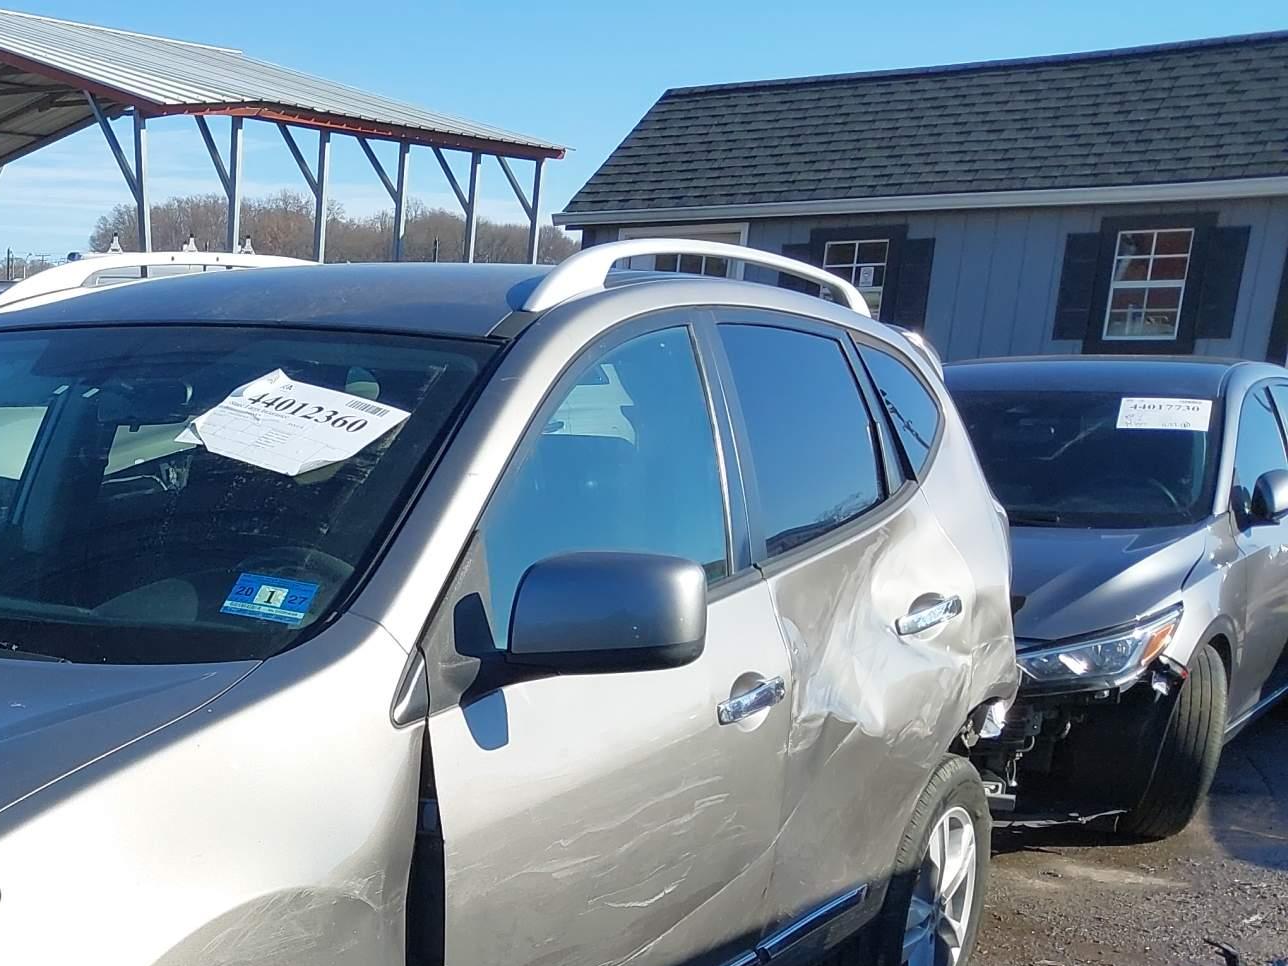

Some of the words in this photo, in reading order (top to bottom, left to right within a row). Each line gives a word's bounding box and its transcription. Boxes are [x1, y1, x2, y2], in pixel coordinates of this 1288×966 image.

[248, 392, 368, 433] 44012360
[236, 586, 254, 597] 20
[263, 590, 277, 604] 1
[287, 595, 308, 606] 27
